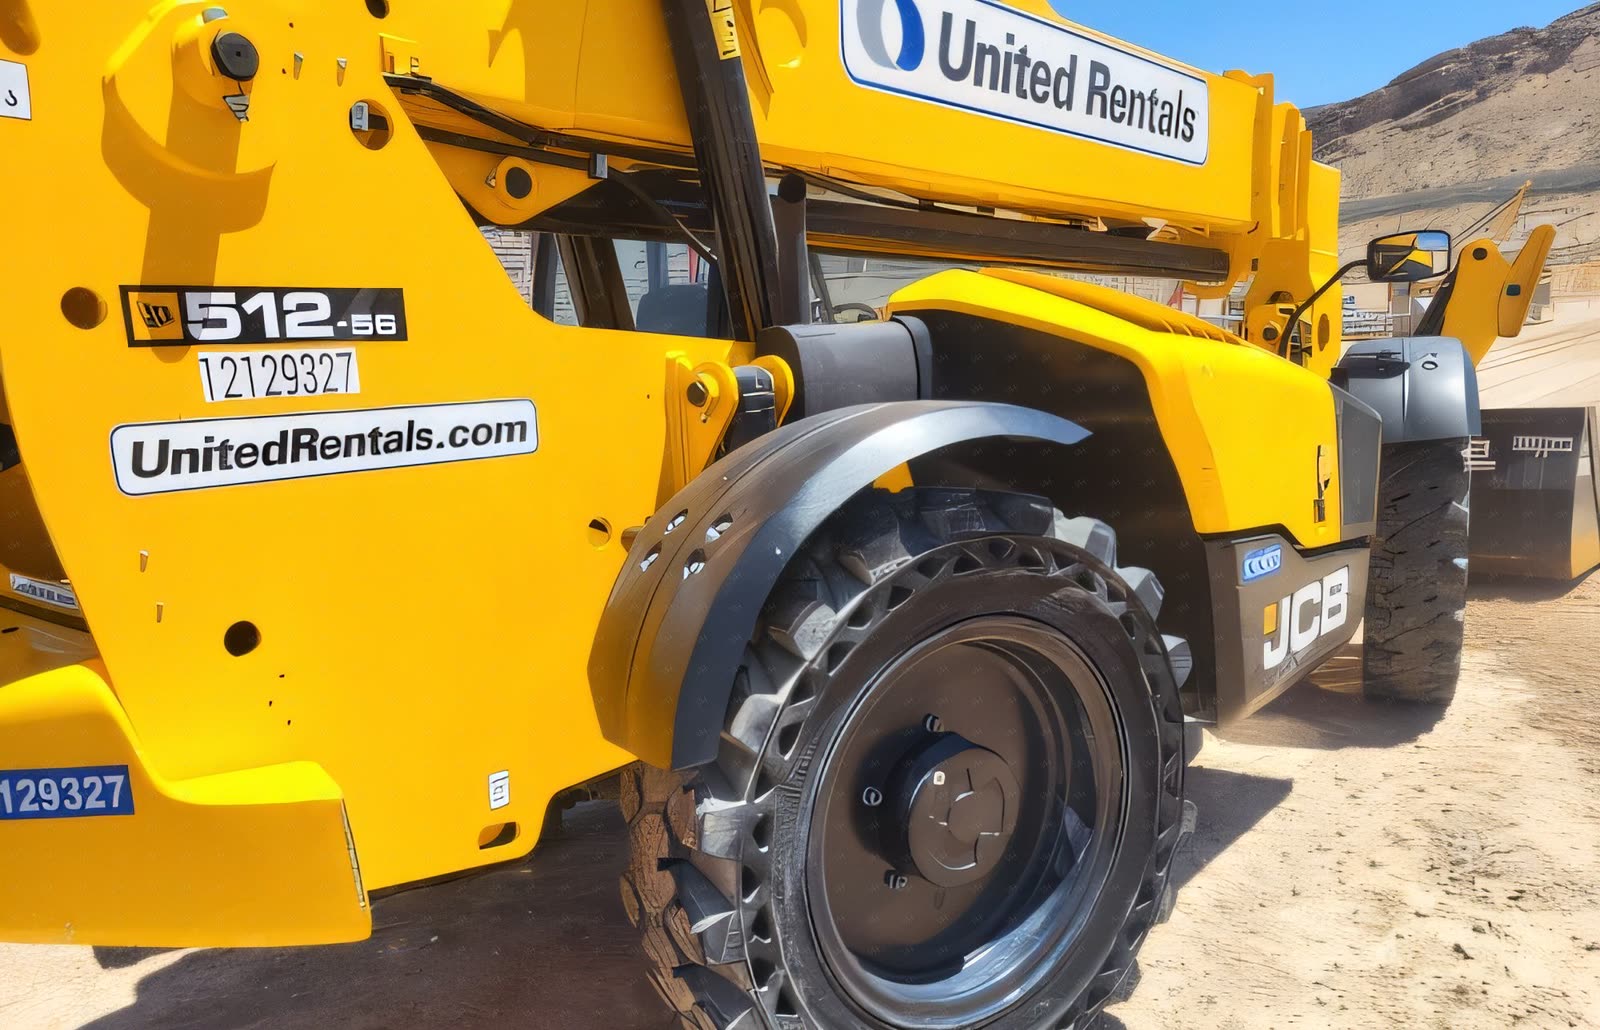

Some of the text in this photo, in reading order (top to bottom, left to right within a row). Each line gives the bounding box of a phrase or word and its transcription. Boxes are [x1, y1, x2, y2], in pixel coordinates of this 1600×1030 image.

[938, 11, 1196, 143] United Rentals
[184, 291, 397, 341] 512-56
[198, 351, 353, 401] 12129327
[131, 419, 527, 478] UnitedRentals.com
[1263, 564, 1349, 670] JCB
[0, 775, 125, 814] 129327
